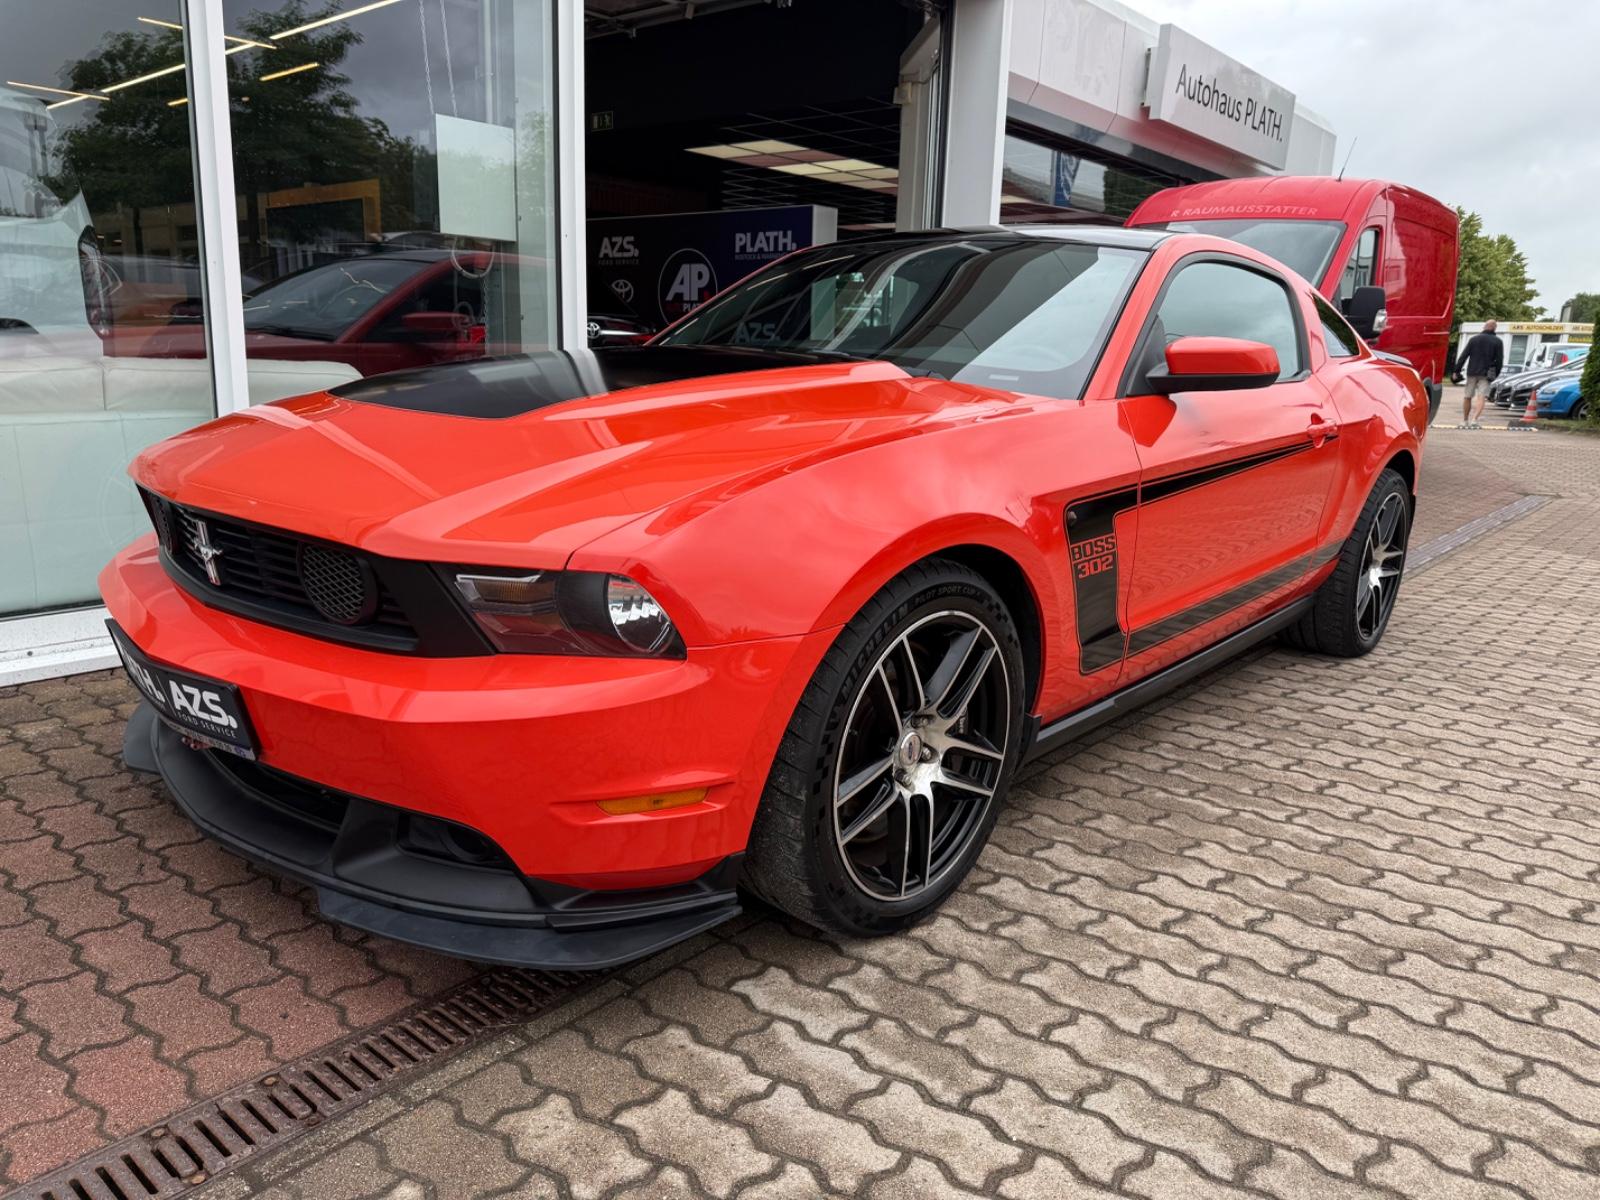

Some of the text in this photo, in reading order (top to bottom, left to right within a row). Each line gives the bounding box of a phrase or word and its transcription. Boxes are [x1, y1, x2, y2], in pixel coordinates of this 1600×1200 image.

[1175, 63, 1283, 142] Autohaus PLATH.
[1182, 204, 1318, 217] RAUMAUSSTATTER
[735, 230, 797, 253] PLATH.
[1070, 535, 1116, 562] BOSS
[1077, 555, 1113, 579] 302
[169, 680, 238, 729] AZS.
[201, 721, 238, 739] SERVICE
